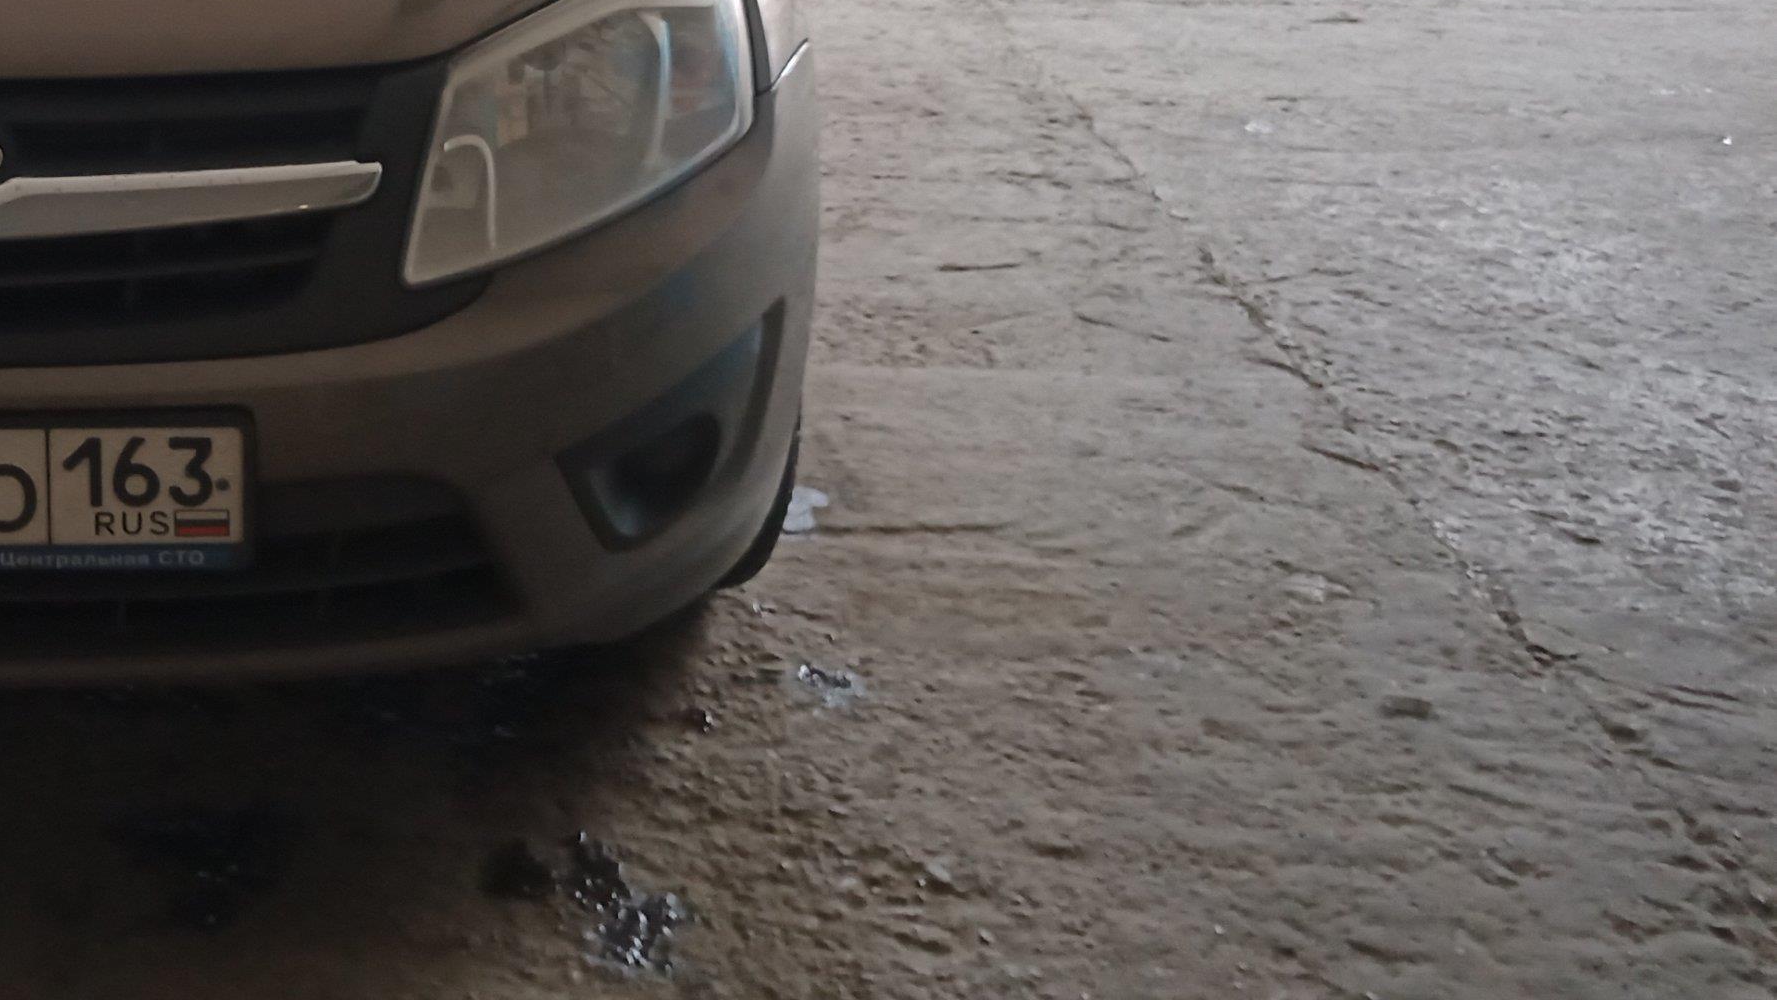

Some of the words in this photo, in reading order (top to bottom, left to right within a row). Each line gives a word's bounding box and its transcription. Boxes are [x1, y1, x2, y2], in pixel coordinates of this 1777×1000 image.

[62, 436, 214, 512] 163
[94, 509, 171, 536] RUS
[0, 551, 150, 569] Центральная
[157, 549, 206, 566] СТО
